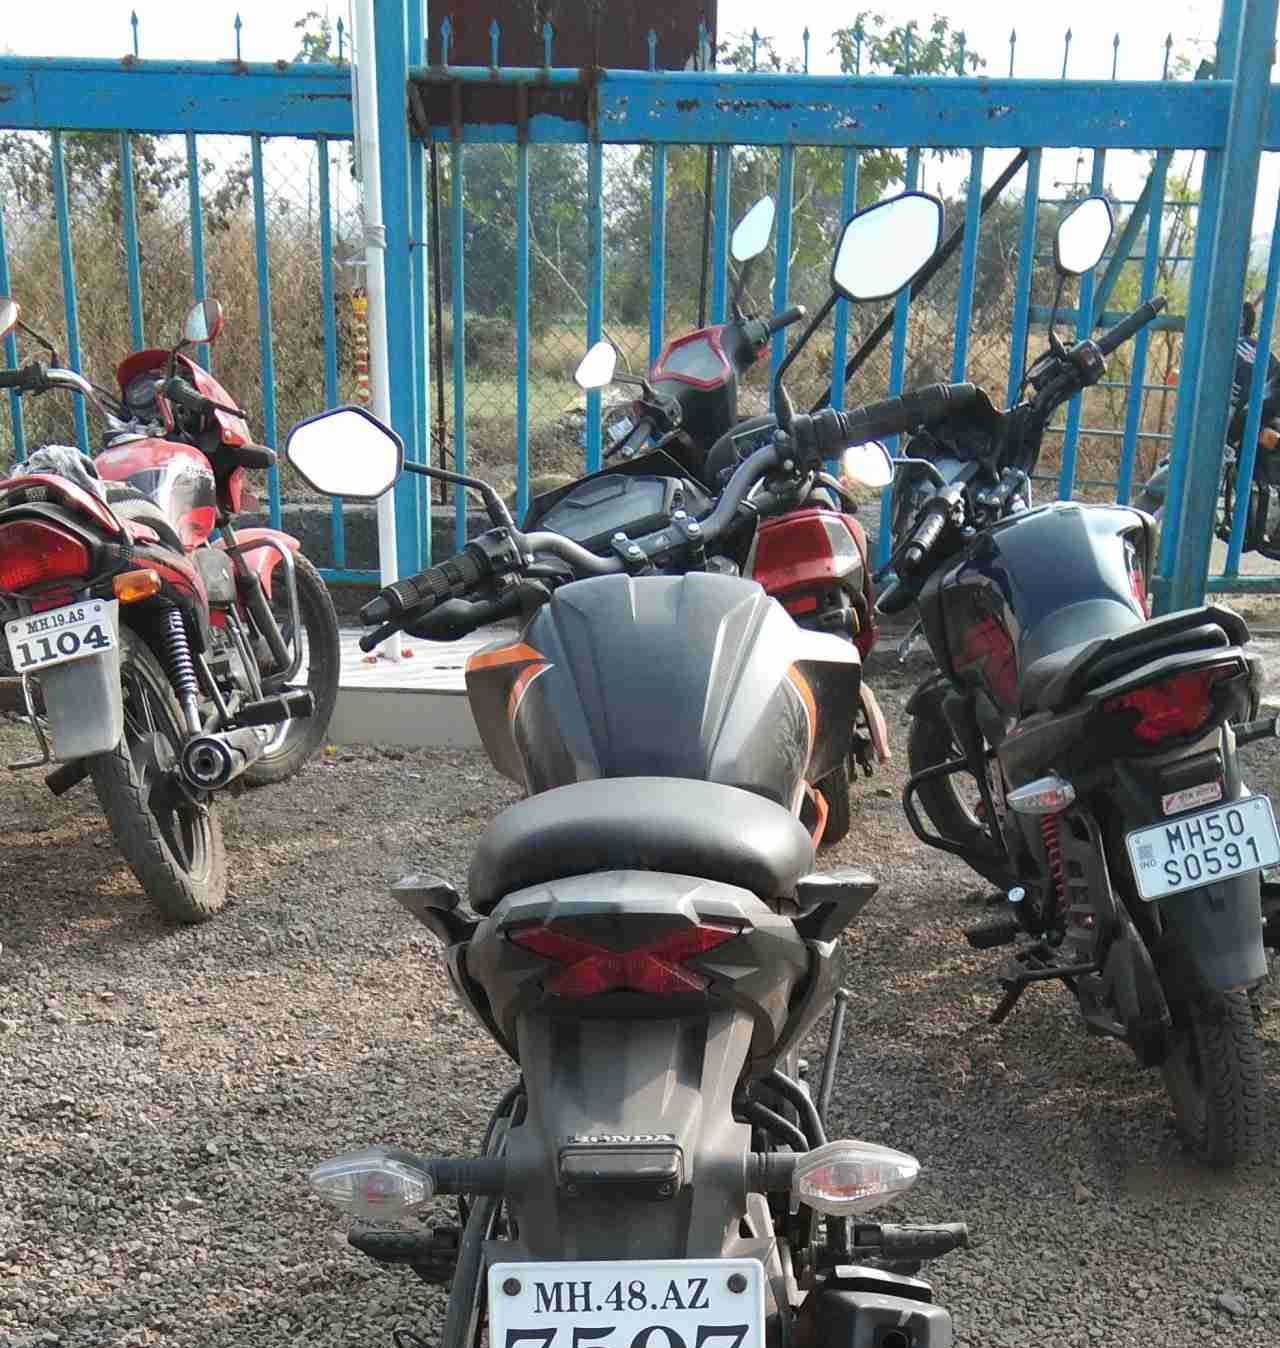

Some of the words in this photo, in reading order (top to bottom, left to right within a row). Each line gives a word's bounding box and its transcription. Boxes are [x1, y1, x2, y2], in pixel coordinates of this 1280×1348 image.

[16, 624, 110, 667] 1104
[1166, 809, 1244, 854] MH50
[1164, 836, 1260, 885] S0591
[533, 1278, 710, 1313] MH.48.AZ
